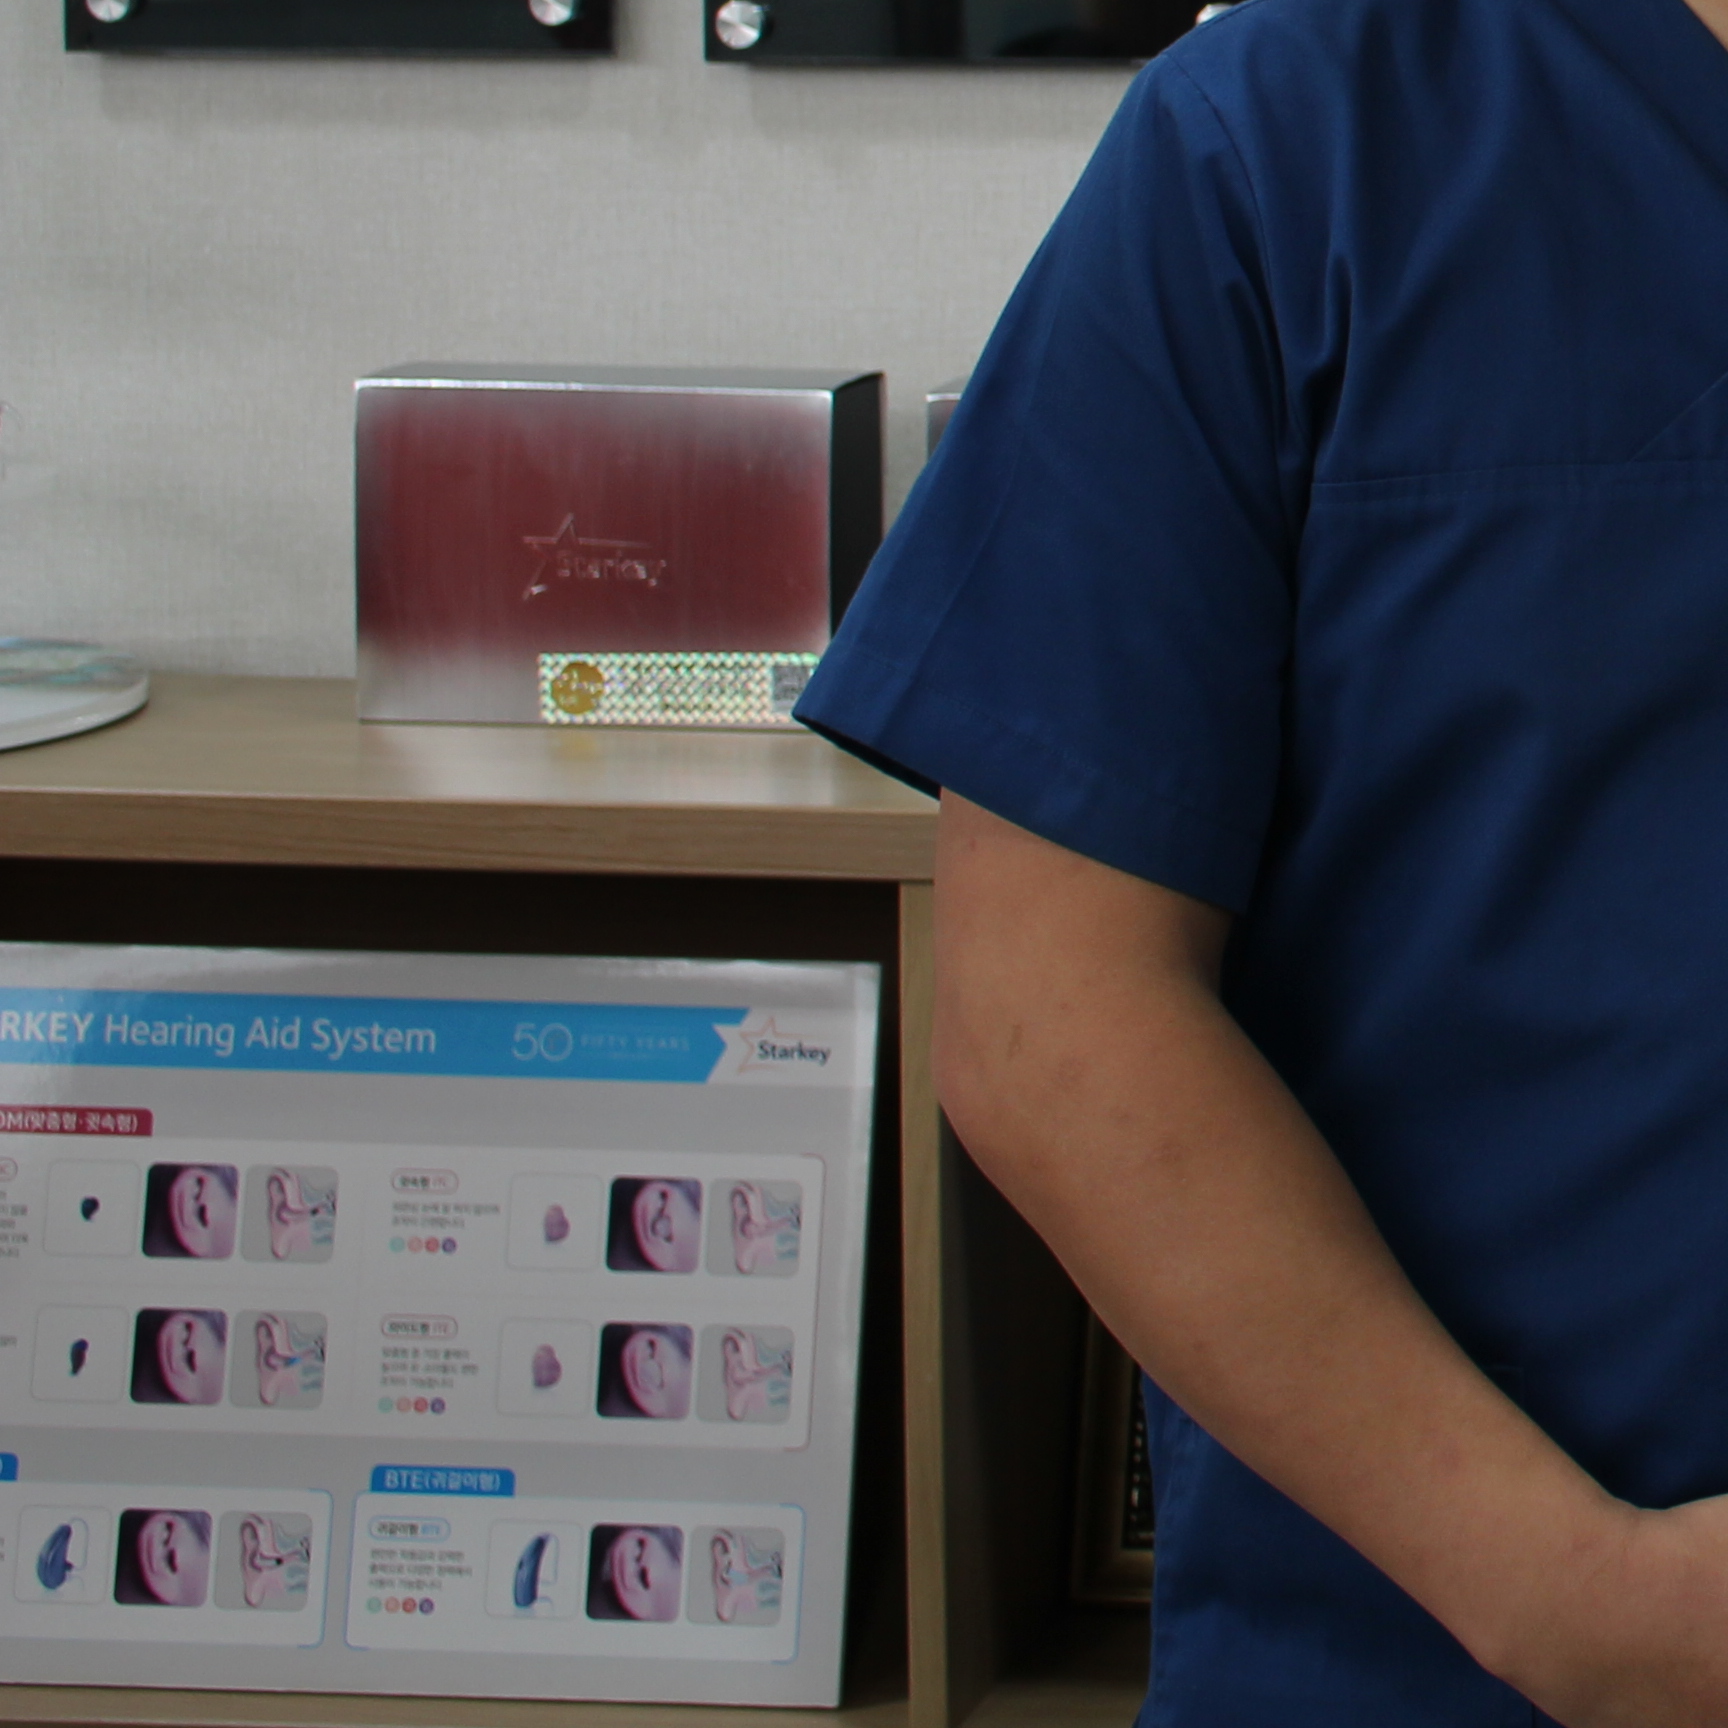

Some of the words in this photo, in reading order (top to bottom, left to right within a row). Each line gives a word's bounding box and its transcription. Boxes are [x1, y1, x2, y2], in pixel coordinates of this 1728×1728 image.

[0, 1010, 94, 1043] RKEY
[105, 1014, 235, 1057] Hearing
[245, 1017, 301, 1050] Aid
[311, 1018, 437, 1060] System
[511, 1023, 574, 1062] 50
[757, 1040, 832, 1066] Starkey
